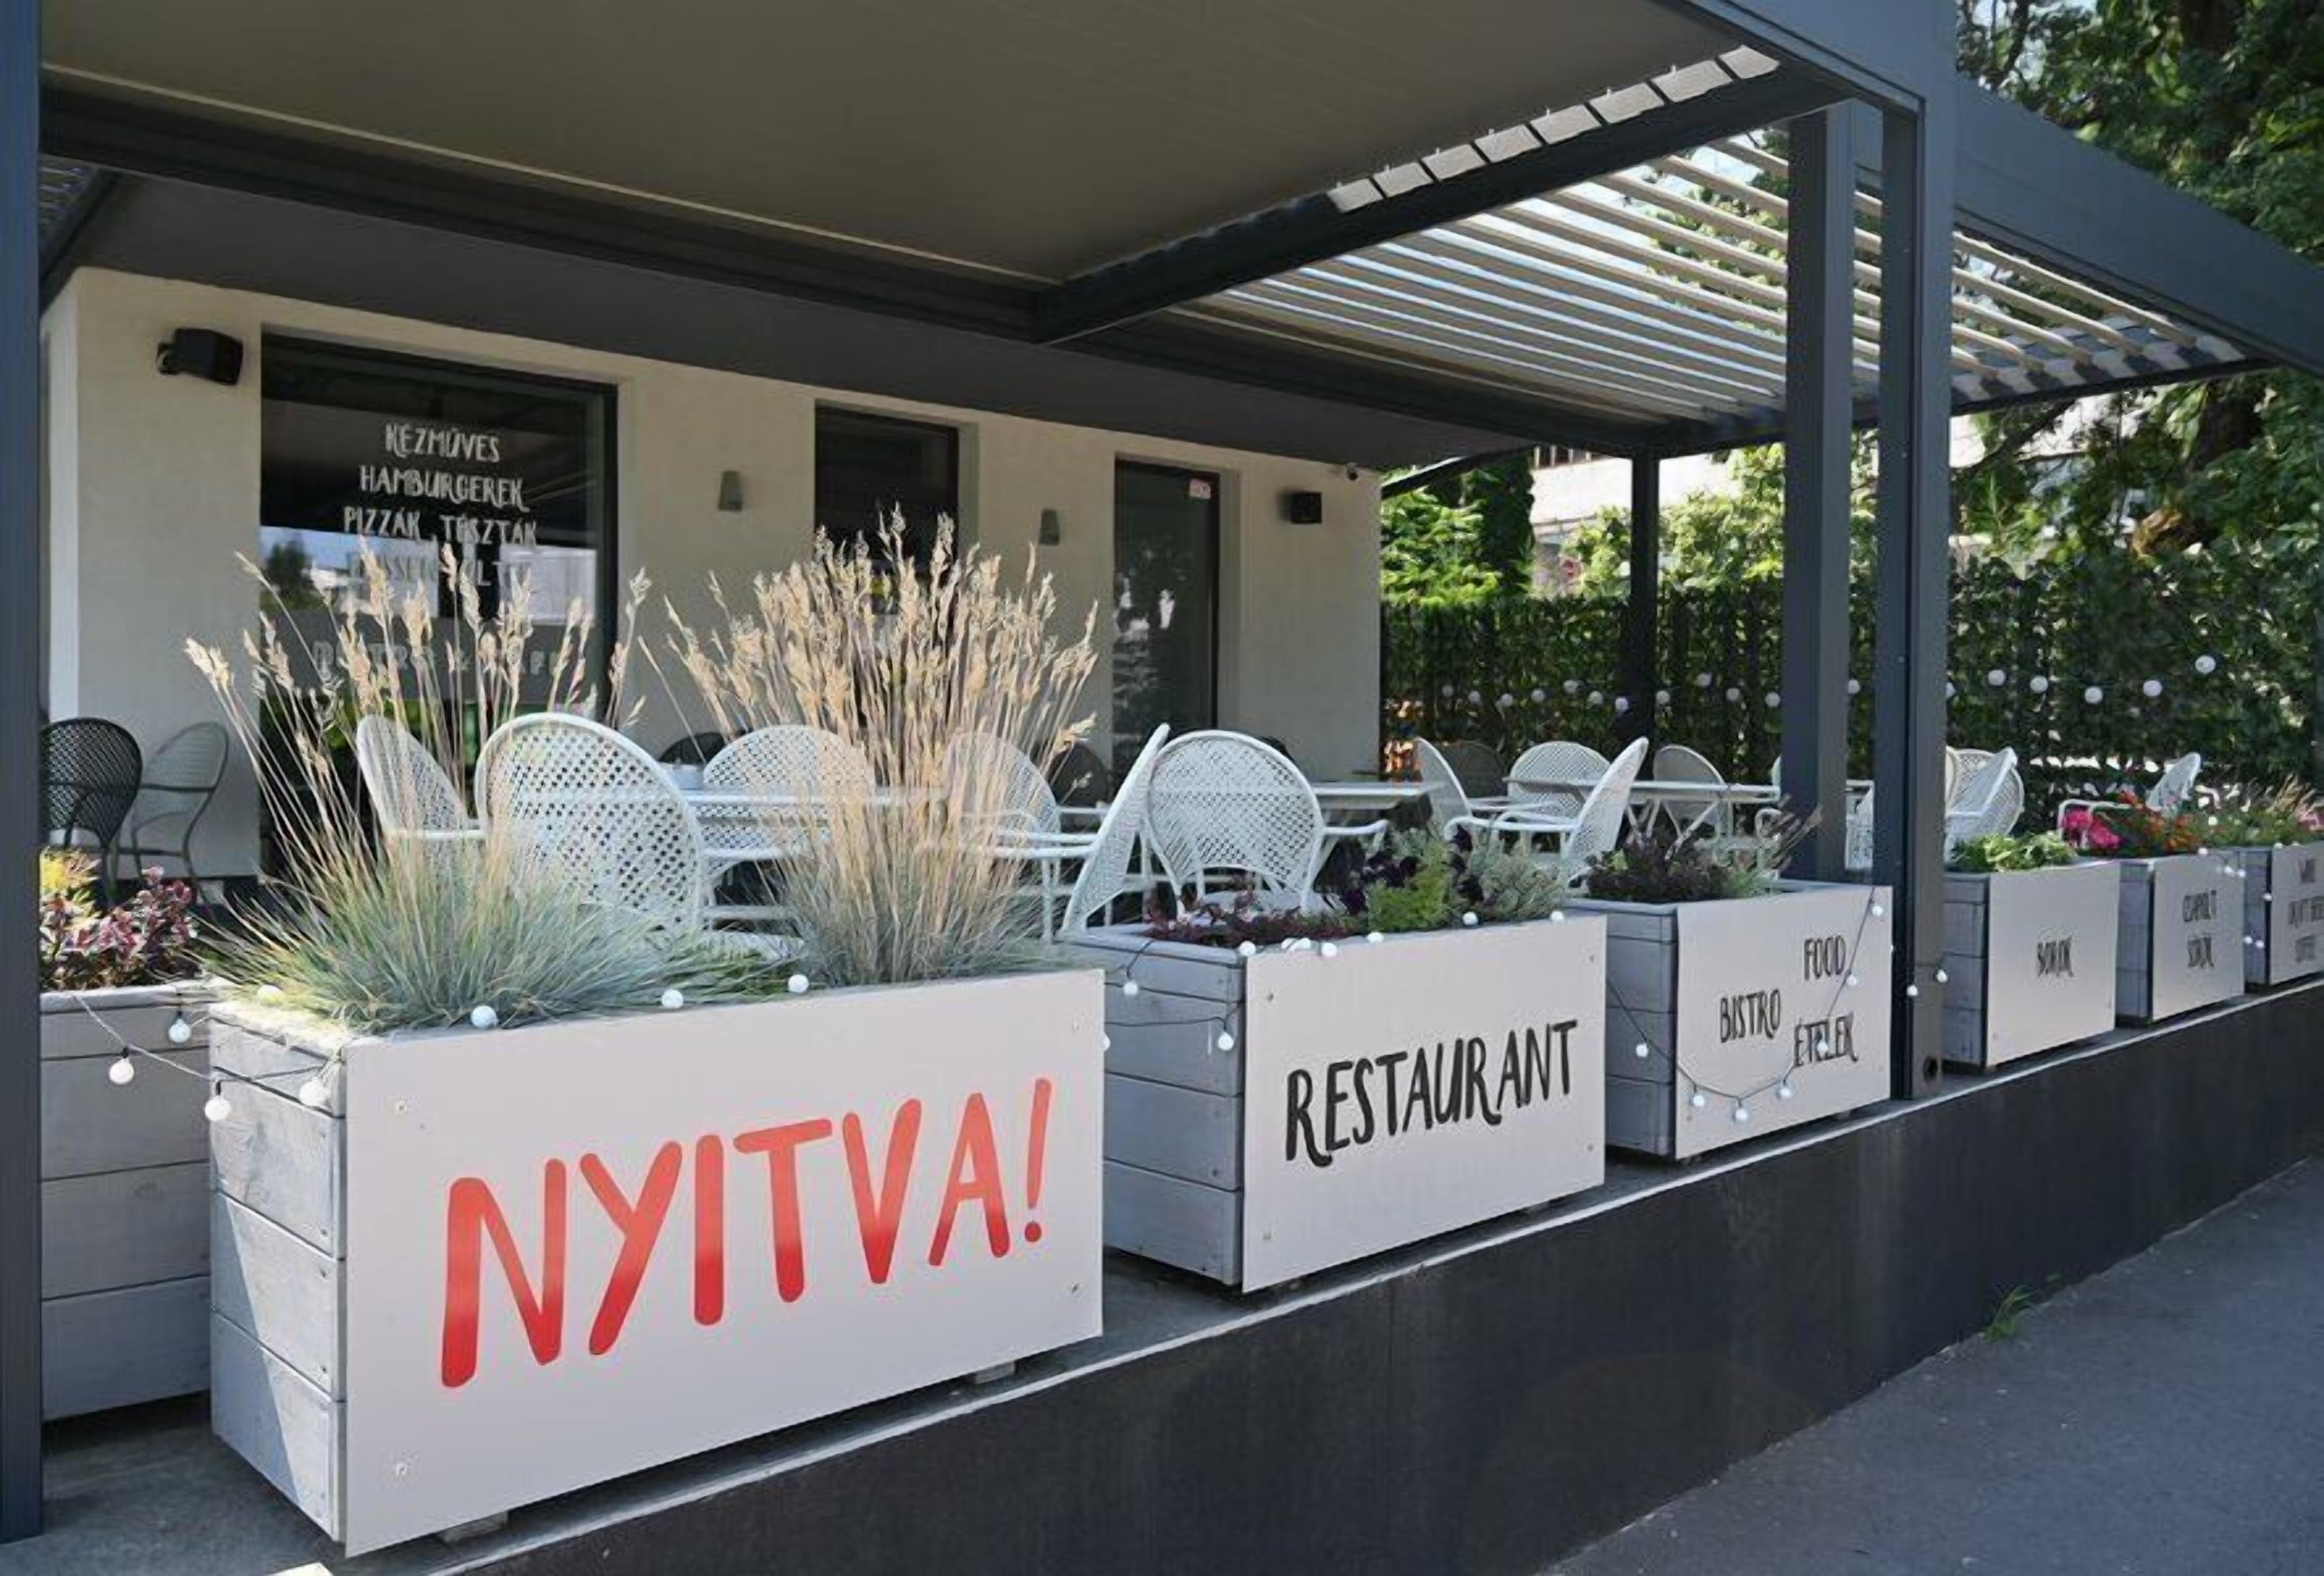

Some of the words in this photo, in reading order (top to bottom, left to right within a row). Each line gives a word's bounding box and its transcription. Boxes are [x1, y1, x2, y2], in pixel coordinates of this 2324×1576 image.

[360, 464, 530, 512] HAMBURGEREK
[1804, 935, 1847, 980] FOOD
[1719, 989, 1782, 1043] BISTRO
[1285, 1019, 1578, 1168] RESTAURANT
[441, 1078, 1052, 1388] NYITVA!
